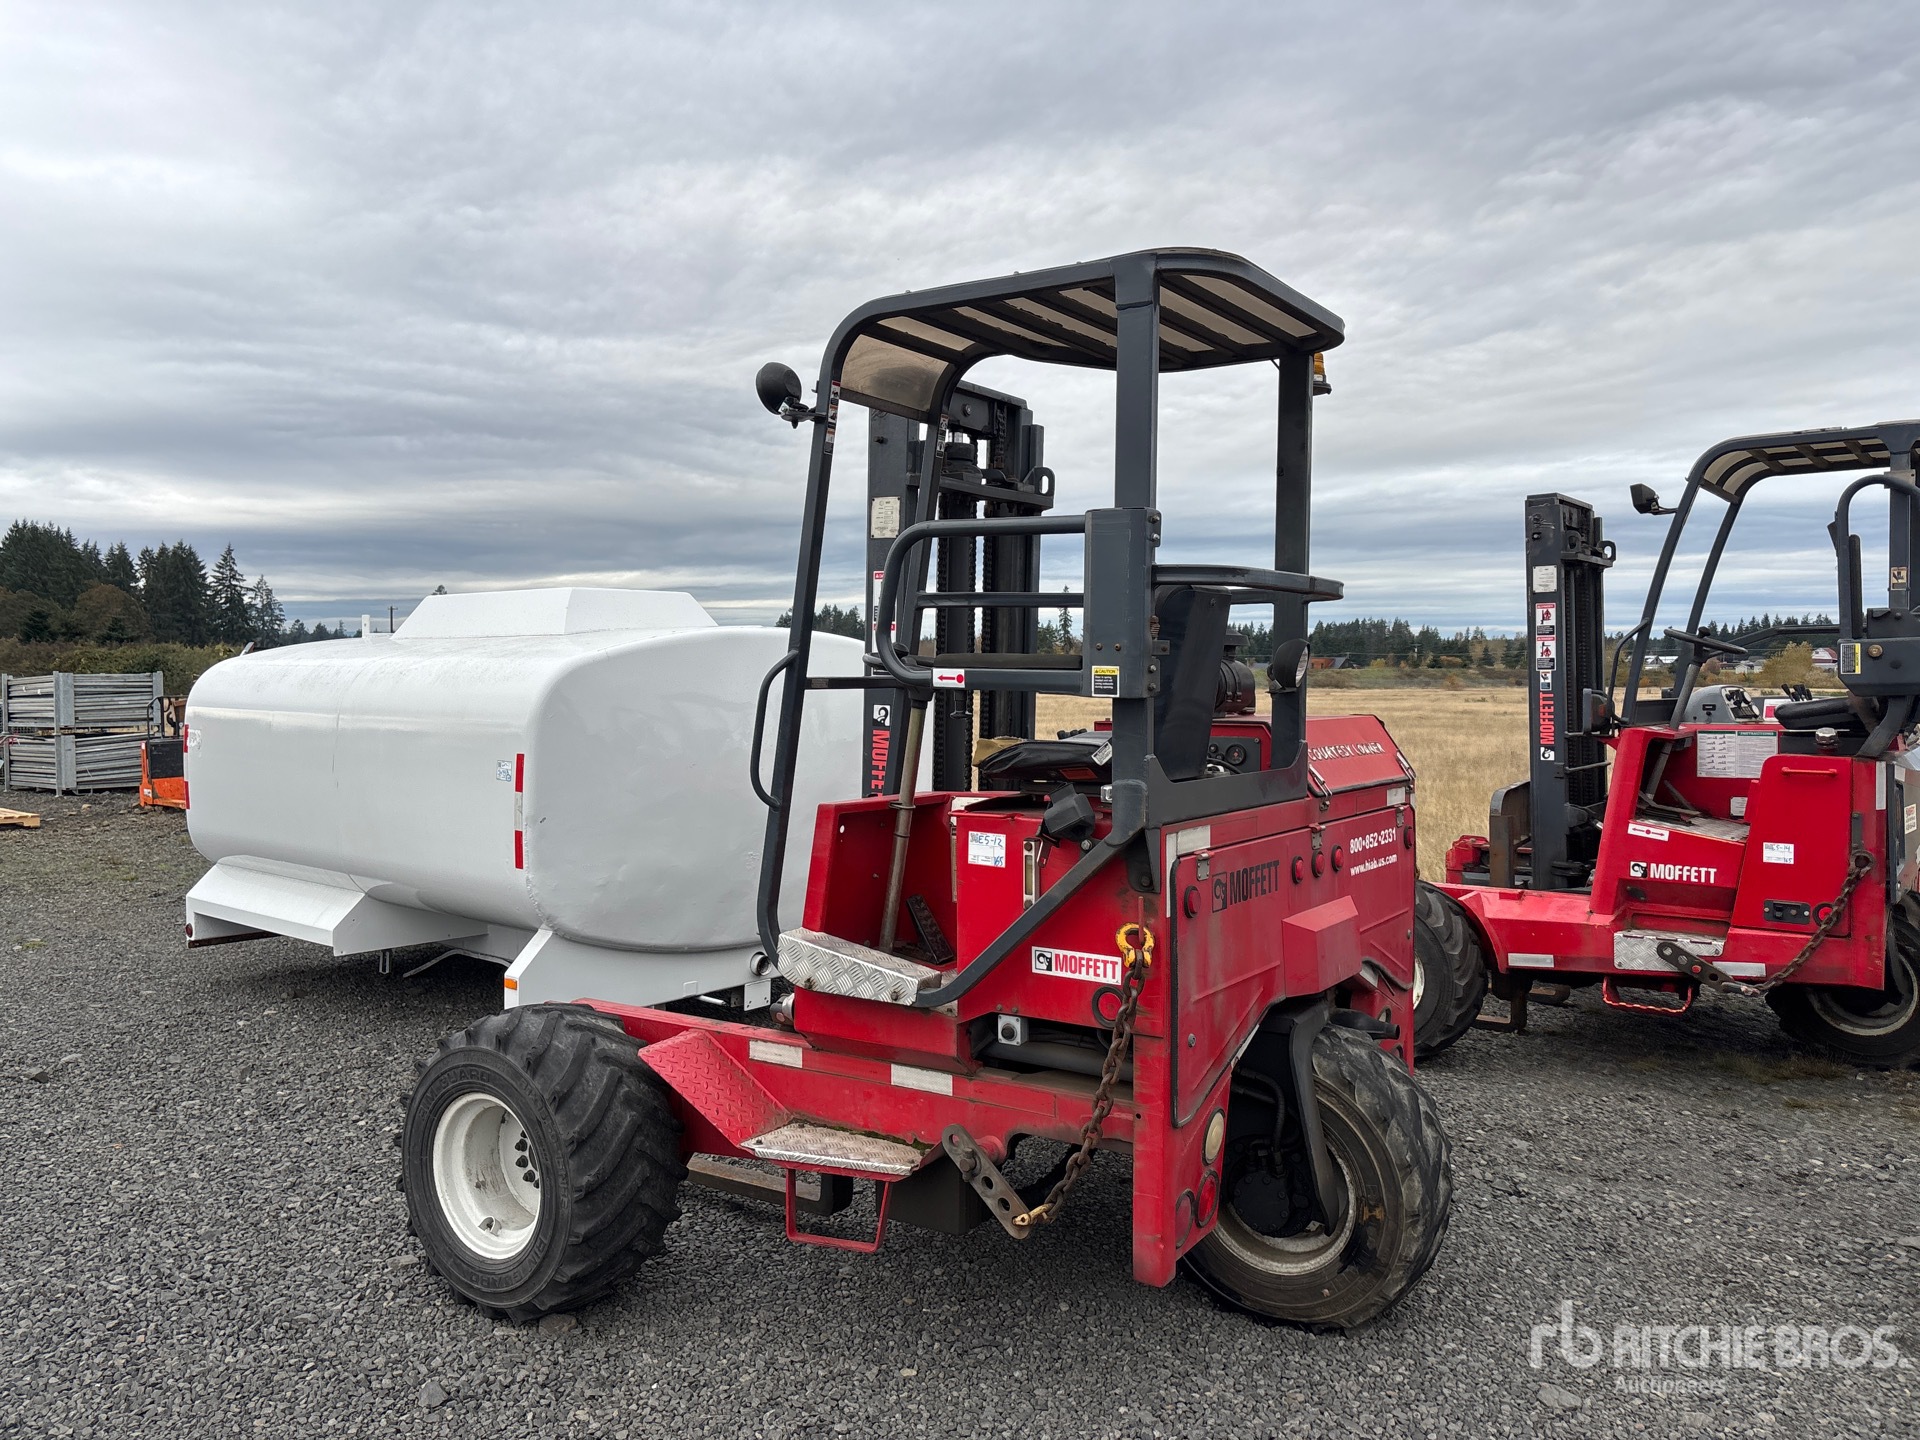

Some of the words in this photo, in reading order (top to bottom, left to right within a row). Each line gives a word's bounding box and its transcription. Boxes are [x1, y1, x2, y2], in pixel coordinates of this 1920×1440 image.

[1540, 692, 1555, 745] MOFFETT
[1308, 745, 1354, 761] COURTESY
[1349, 853, 1398, 877] www.hiab.us.com
[1649, 862, 1718, 884] MOFFETT
[1229, 859, 1280, 906] MOFFETT
[1054, 953, 1119, 980] MOFFETT
